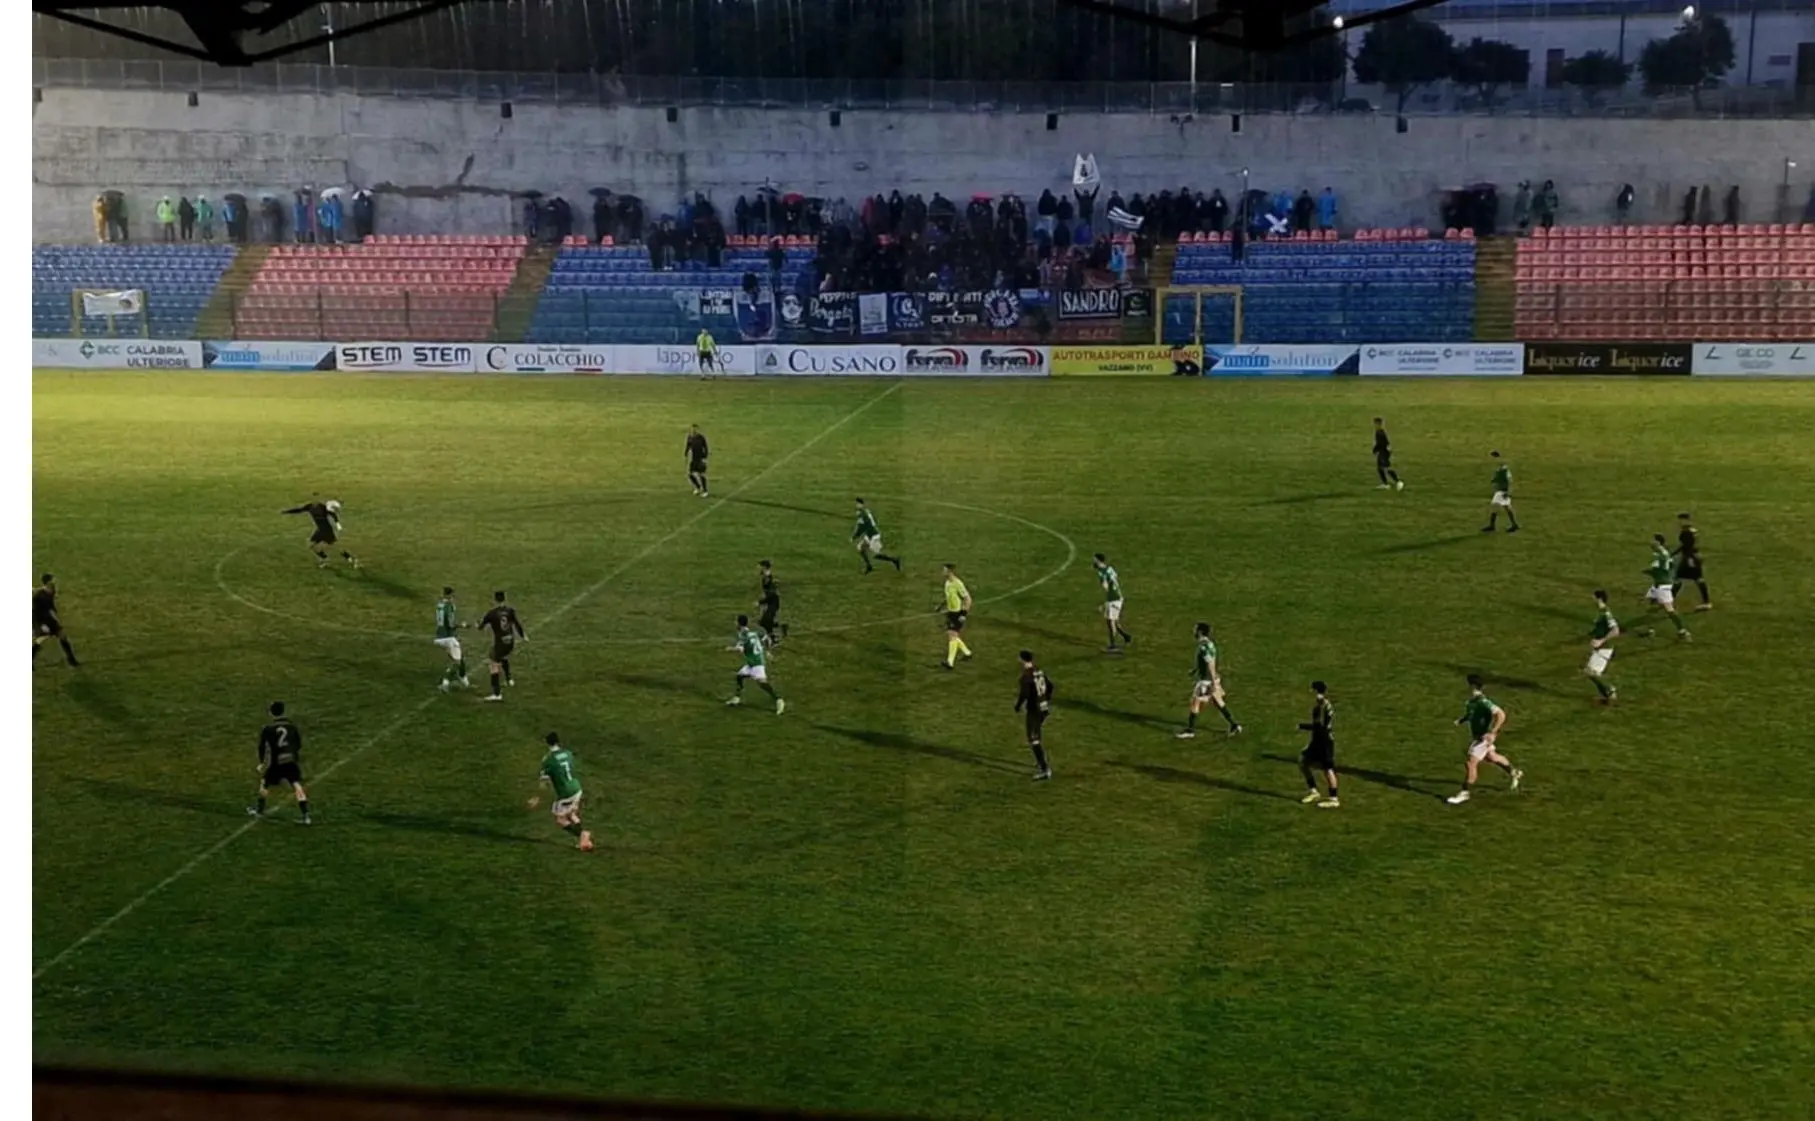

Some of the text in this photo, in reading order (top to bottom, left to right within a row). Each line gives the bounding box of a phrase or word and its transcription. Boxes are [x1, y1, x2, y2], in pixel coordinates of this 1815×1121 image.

[1063, 290, 1119, 312] SANDRO
[97, 345, 120, 355] BCC
[127, 345, 185, 355] CALABRIA
[342, 346, 402, 361] STEM
[413, 347, 471, 362] STEM
[1053, 350, 1144, 361] AUTOTRASPORTI
[127, 358, 190, 368] ULTERIORE
[514, 353, 605, 366] COLACCHIO
[275, 726, 289, 748] 2
